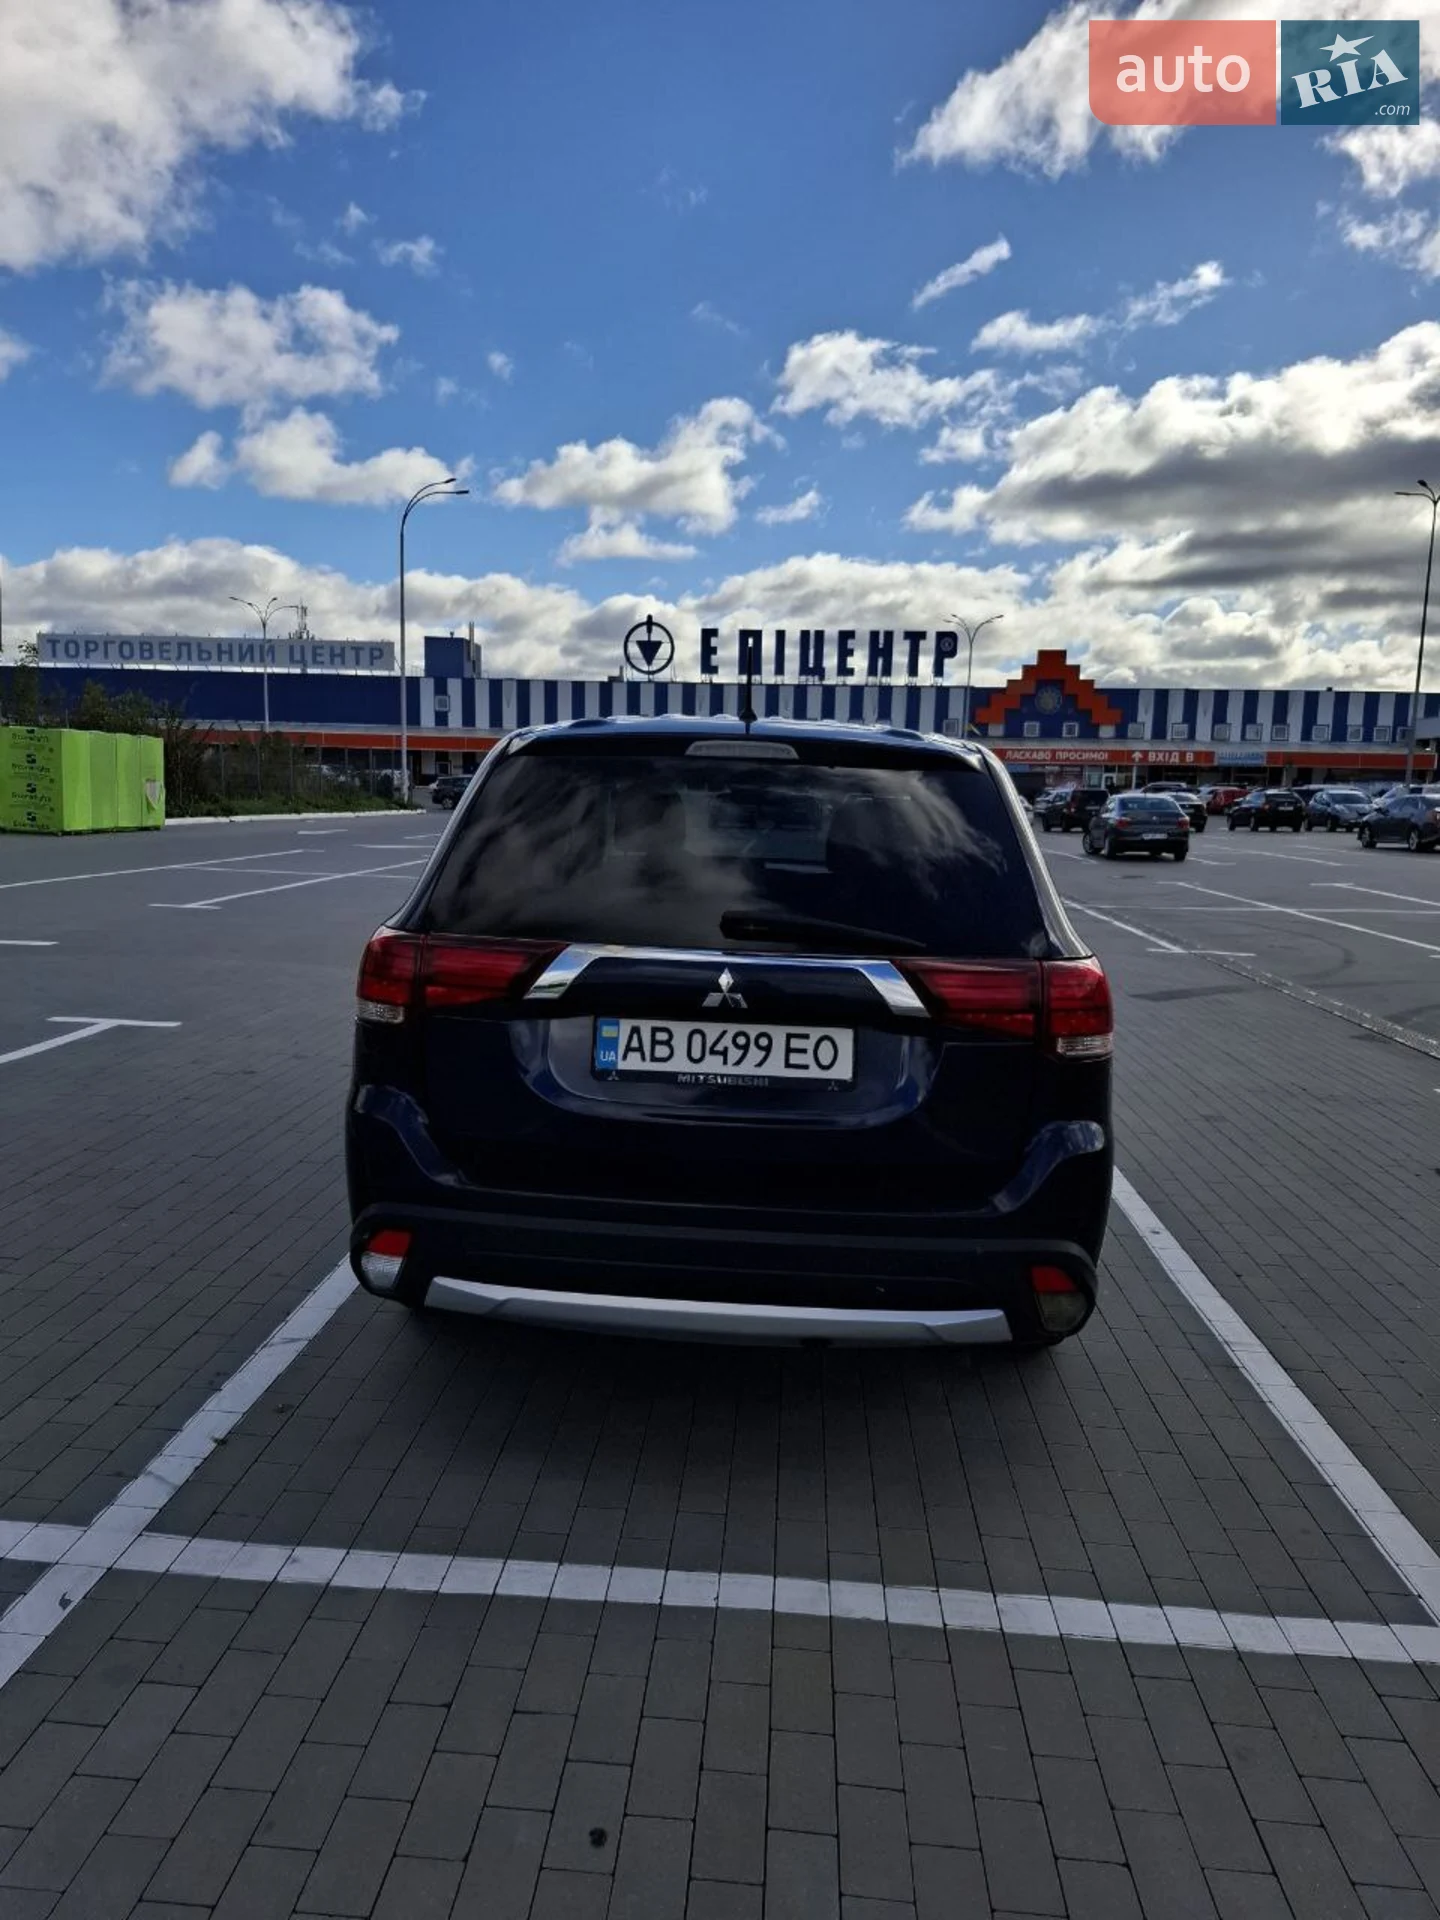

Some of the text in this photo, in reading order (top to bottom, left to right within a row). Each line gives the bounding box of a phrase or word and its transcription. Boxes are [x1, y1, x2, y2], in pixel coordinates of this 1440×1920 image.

[46, 637, 385, 667] ТОРГОВЕЛЬНИЙ ЦЕНТР
[702, 628, 958, 681] ЕПІЦЕНТР
[1004, 750, 1052, 762] ЛАСКАВО
[1147, 751, 1180, 764] ВХІД
[622, 1025, 839, 1071] AB 0499 EO
[599, 1050, 616, 1062] UA
[677, 1074, 770, 1087] MITSUBISHI
